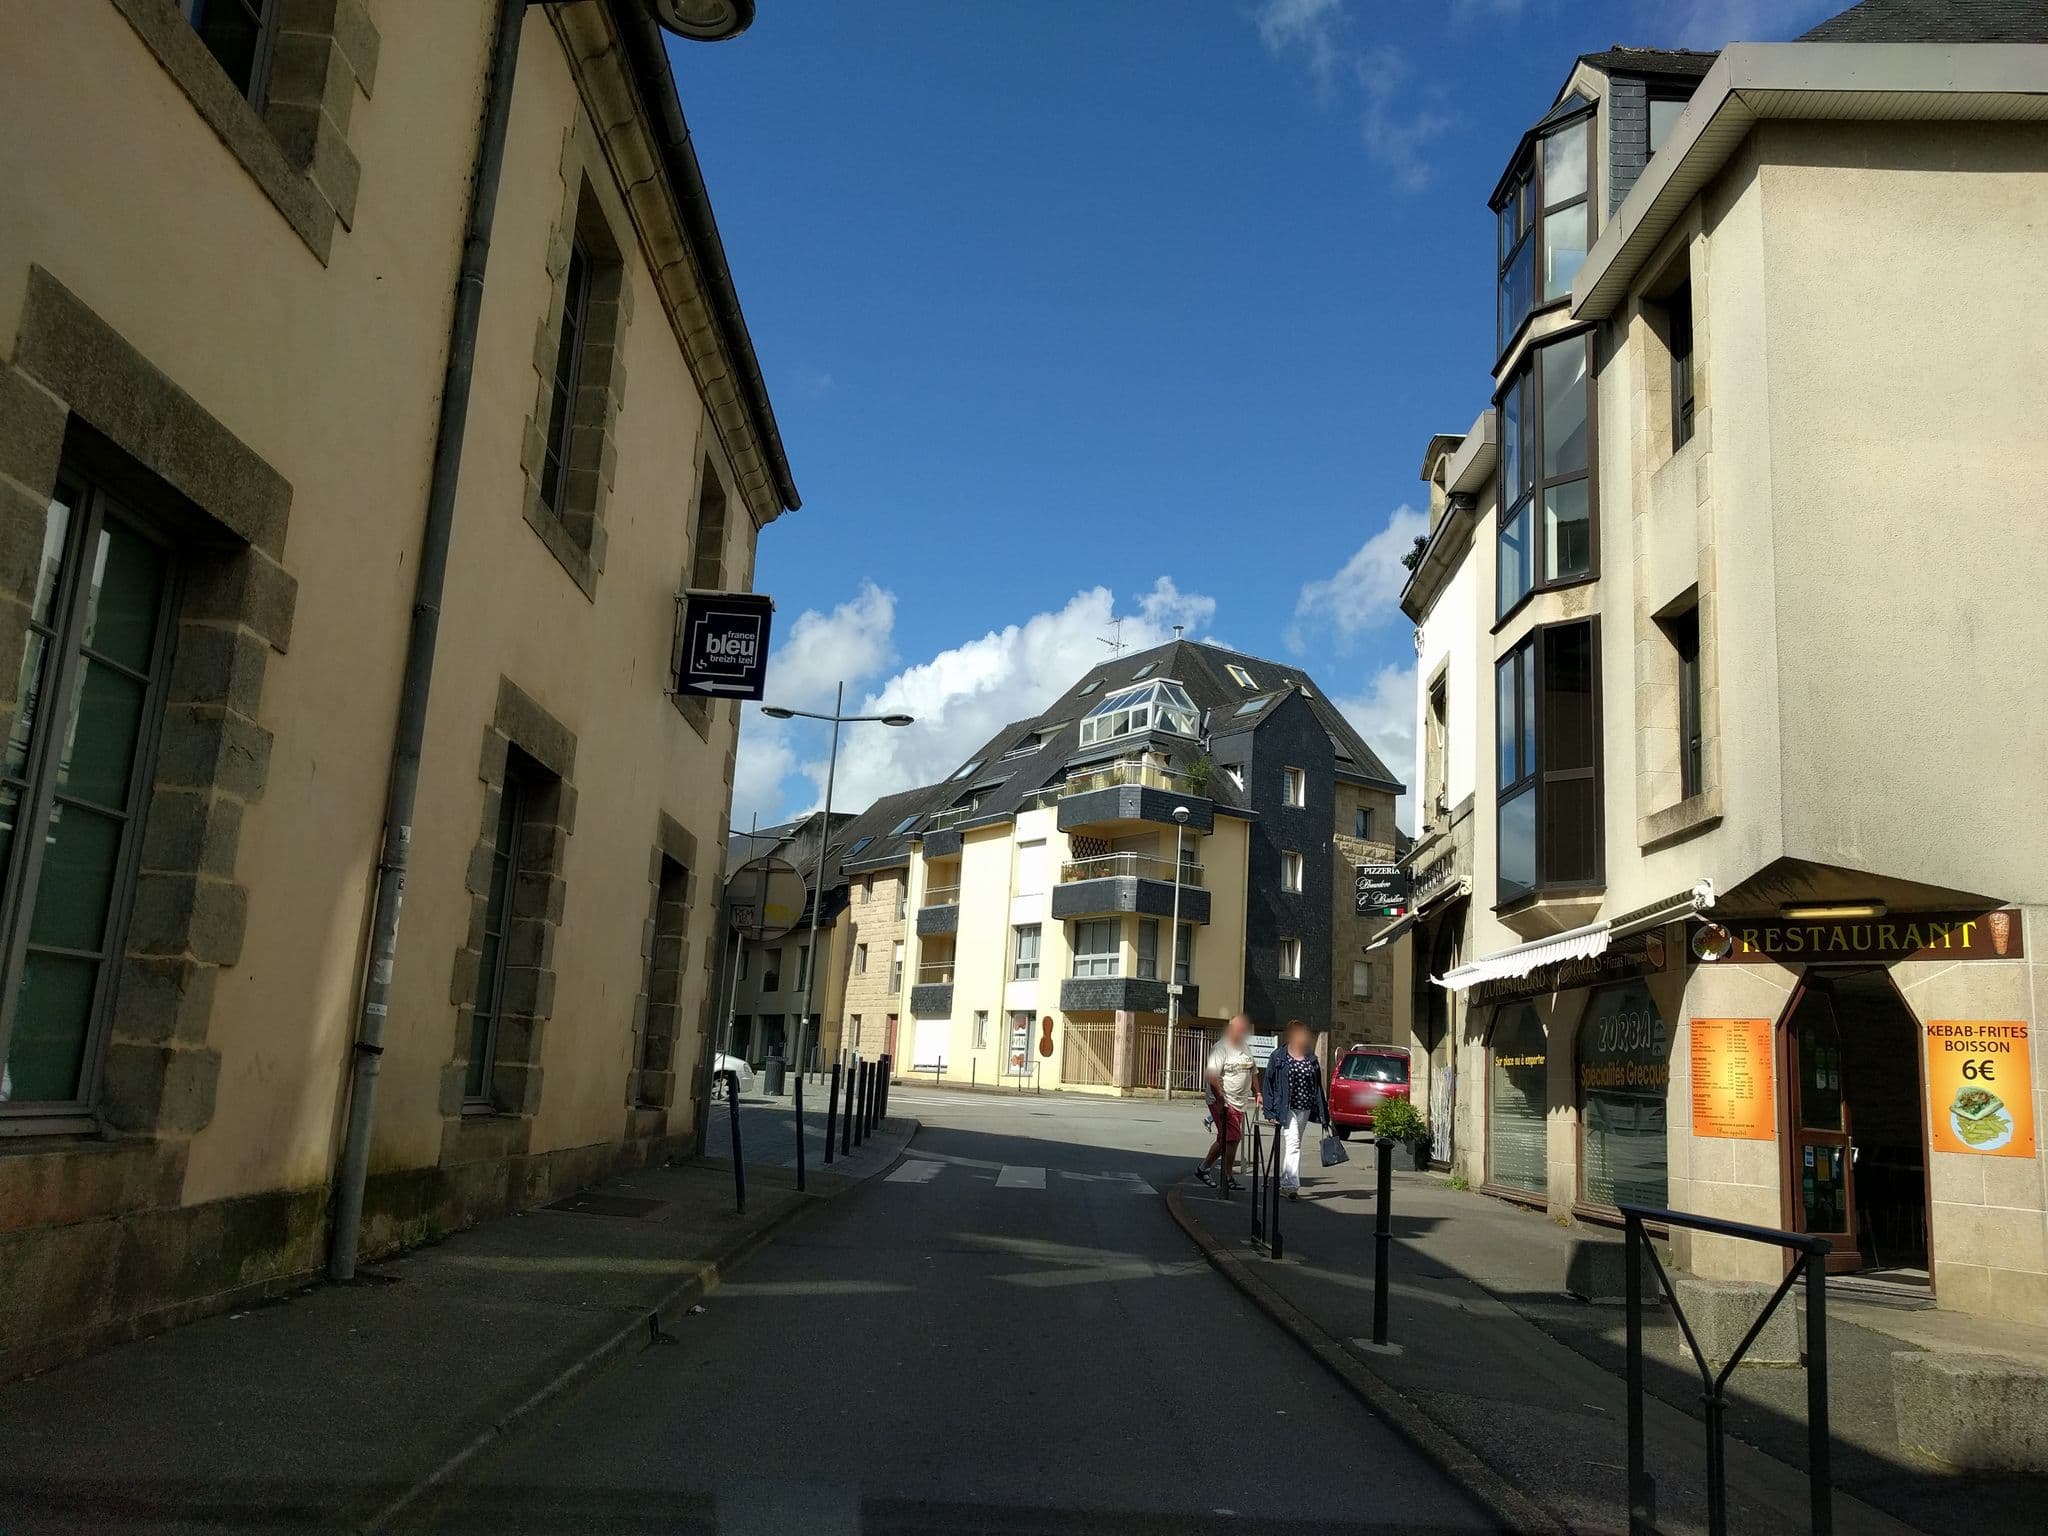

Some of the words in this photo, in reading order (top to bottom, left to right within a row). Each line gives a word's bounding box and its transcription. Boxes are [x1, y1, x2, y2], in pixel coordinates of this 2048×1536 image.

[728, 630, 756, 640] france
[706, 633, 755, 656] bleu
[710, 654, 736, 664] breizh
[738, 655, 753, 665] izel
[1364, 867, 1400, 875] PIZZERIA
[1742, 921, 1977, 953] RESTAURANT
[1598, 1010, 1651, 1053] ZORBA
[1927, 1025, 2029, 1039] KEBAB-FRITES
[1945, 1040, 2010, 1053] BOISSON
[1962, 1059, 1996, 1081] 6€
